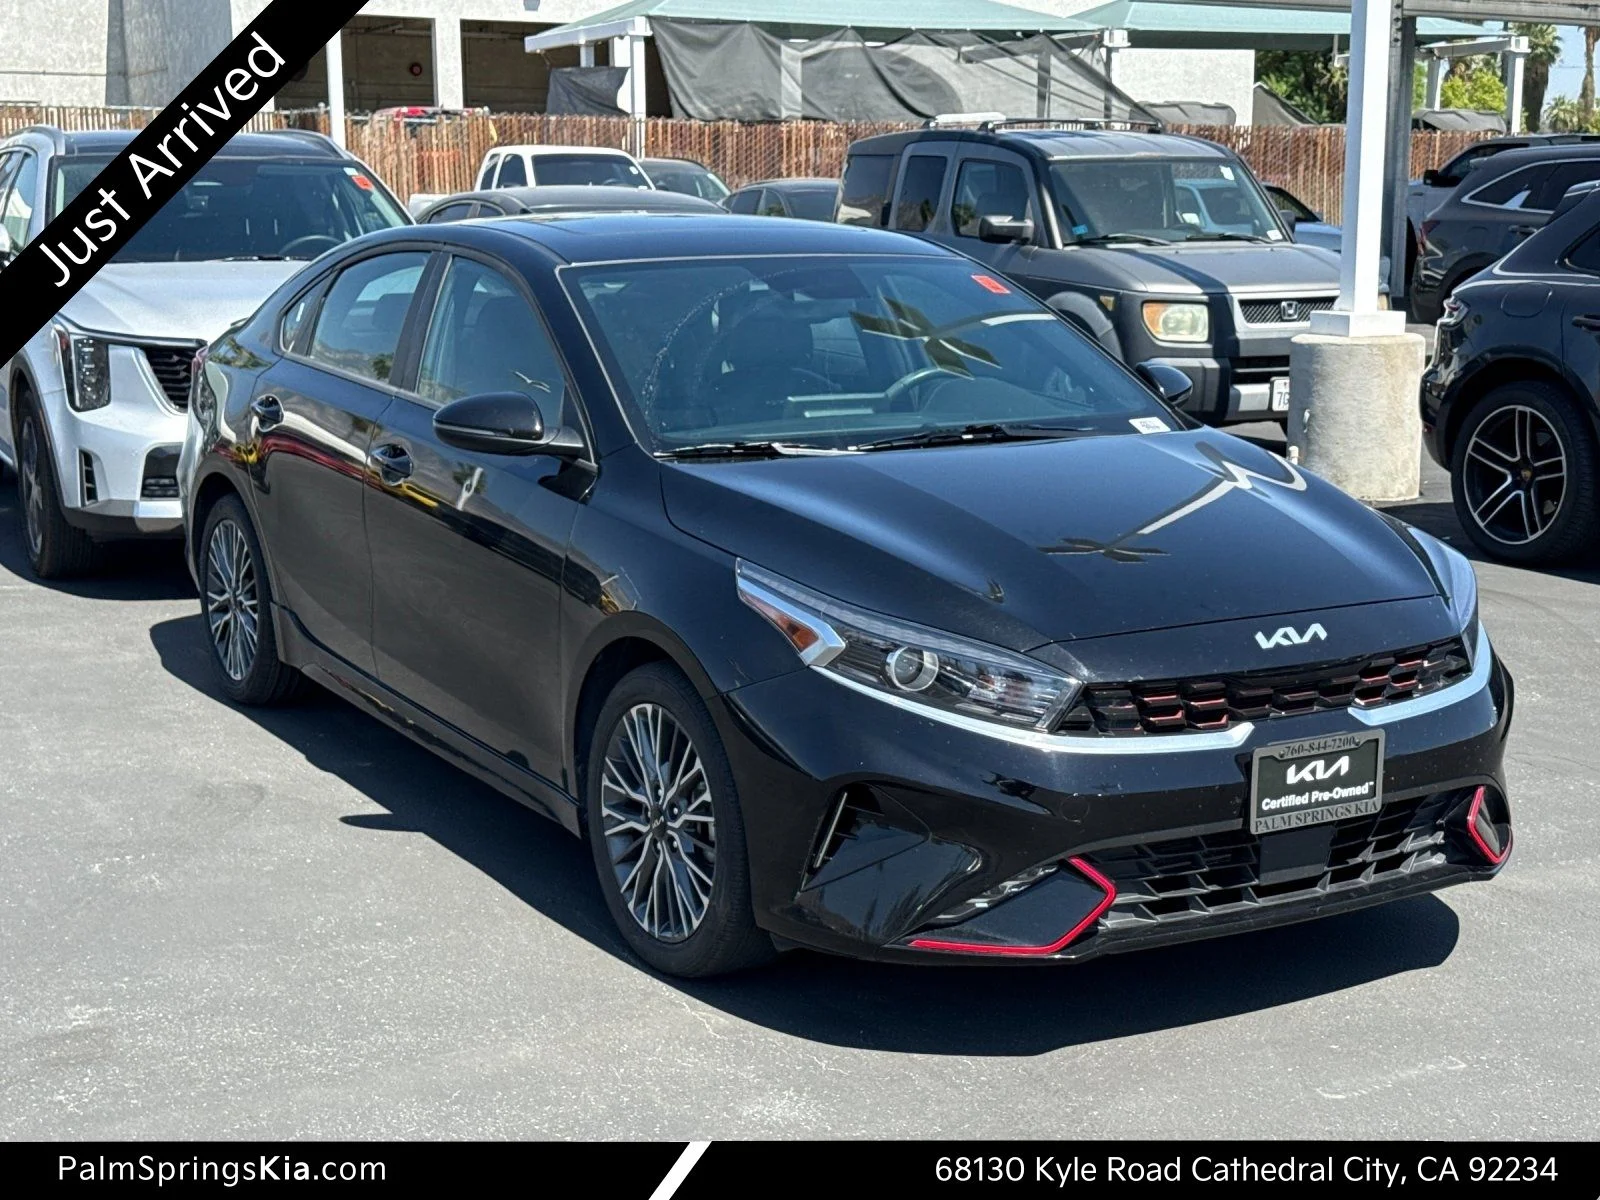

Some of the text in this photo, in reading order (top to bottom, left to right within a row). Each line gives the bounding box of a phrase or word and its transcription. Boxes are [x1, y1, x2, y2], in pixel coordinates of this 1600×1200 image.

[1285, 736, 1355, 757] 760-844-7200
[1262, 792, 1309, 811] Certified
[1255, 800, 1378, 833] PALM SPRINGS KIA
